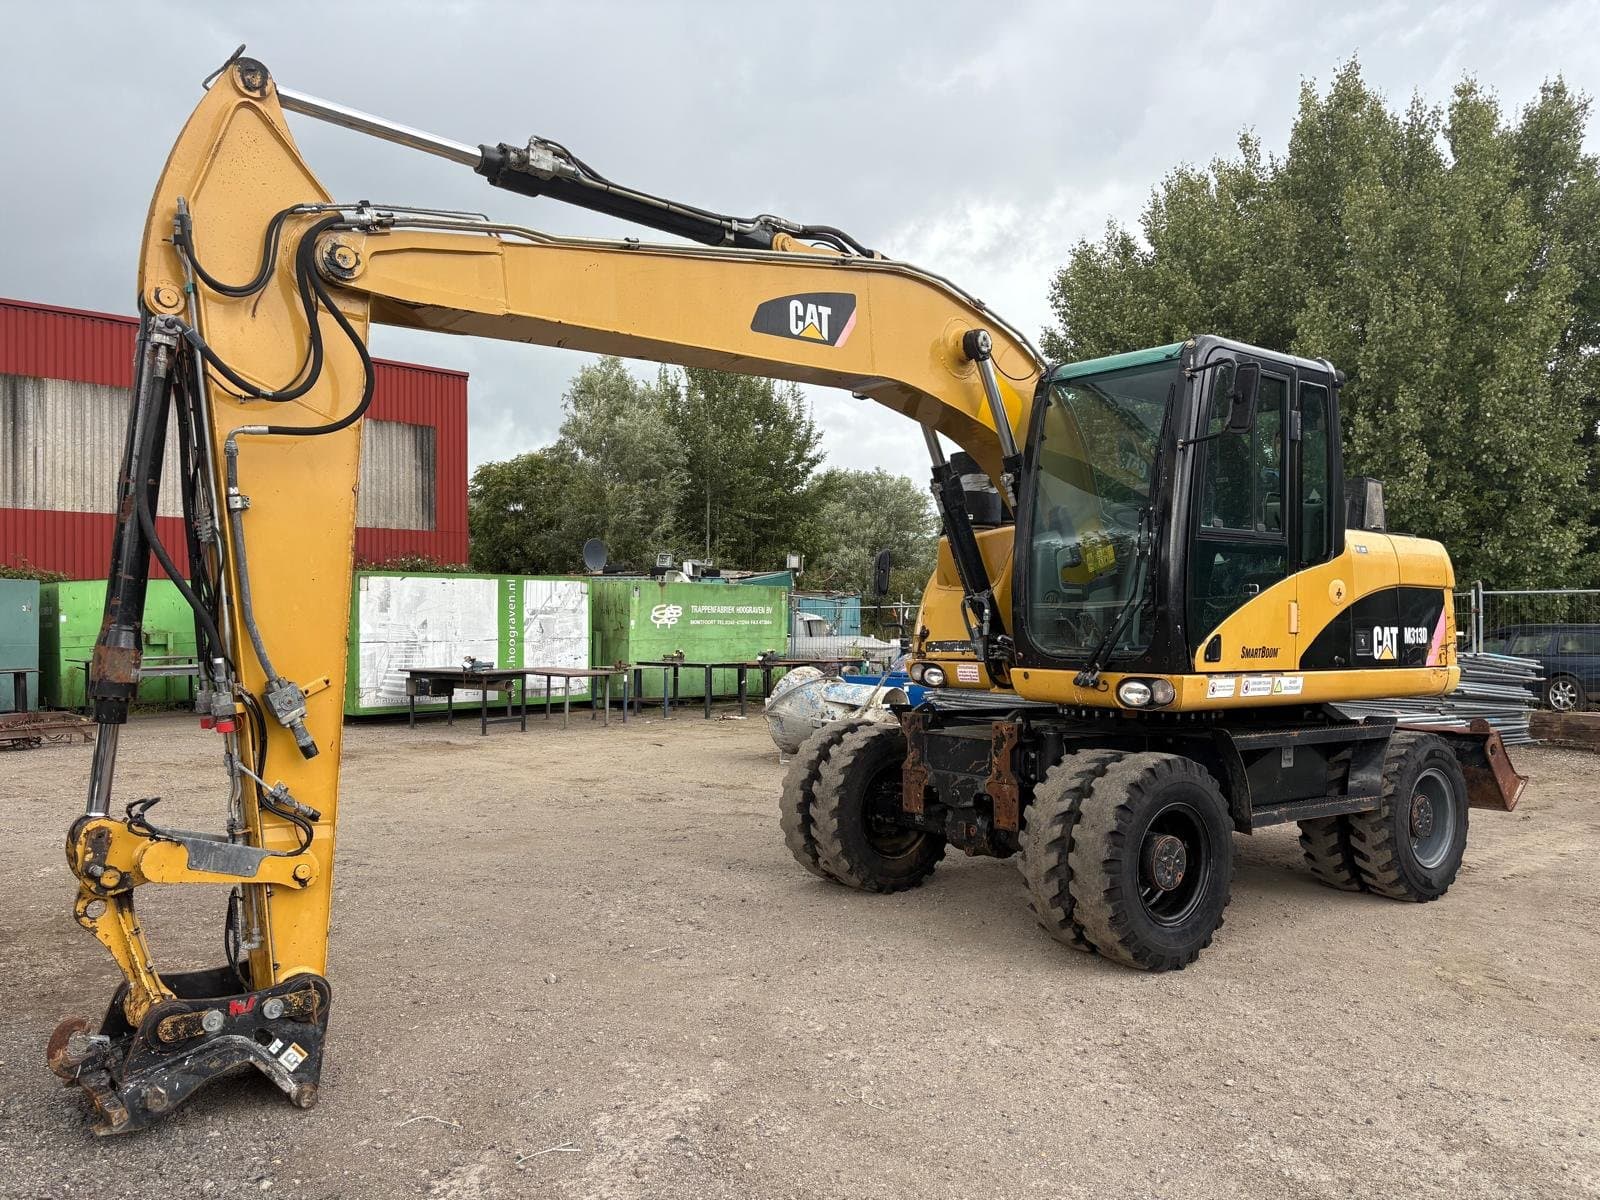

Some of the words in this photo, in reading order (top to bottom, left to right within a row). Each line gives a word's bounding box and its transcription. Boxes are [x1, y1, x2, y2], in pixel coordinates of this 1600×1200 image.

[789, 299, 832, 342] CAT
[691, 605, 735, 614] TRAPPENFABRIEK
[506, 579, 518, 698] .hoograven.nl
[1373, 625, 1398, 660] CAT
[1404, 626, 1428, 644] M313D
